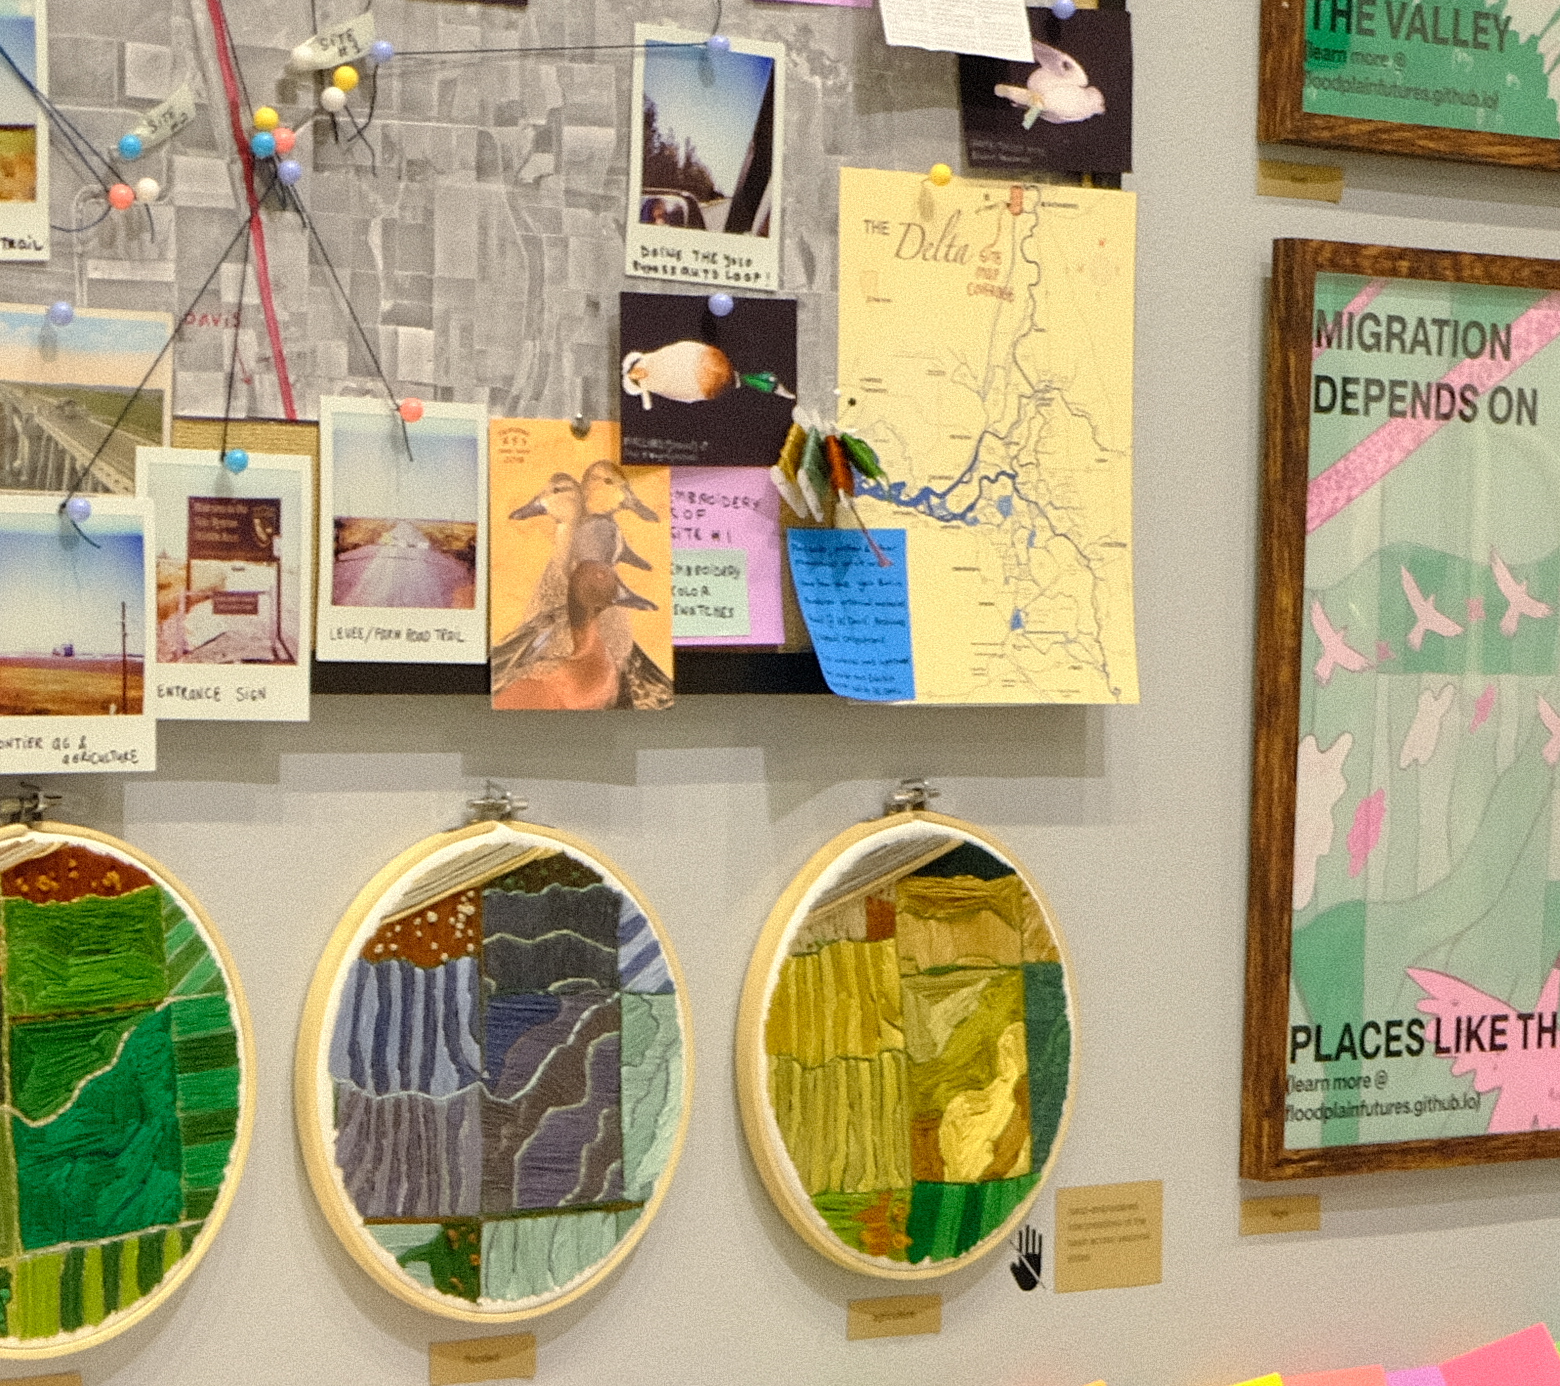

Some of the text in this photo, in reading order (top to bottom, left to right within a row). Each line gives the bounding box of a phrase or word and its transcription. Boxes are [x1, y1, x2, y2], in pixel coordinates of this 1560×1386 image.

[1384, 0, 1513, 54] VALLEY
[863, 208, 972, 264] THE Delta
[1314, 309, 1513, 362] MIGRATION
[1313, 374, 1539, 427] DEPENDS ON
[1289, 1017, 1426, 1064] PLACES
[1434, 1014, 1510, 1056] LIKE
